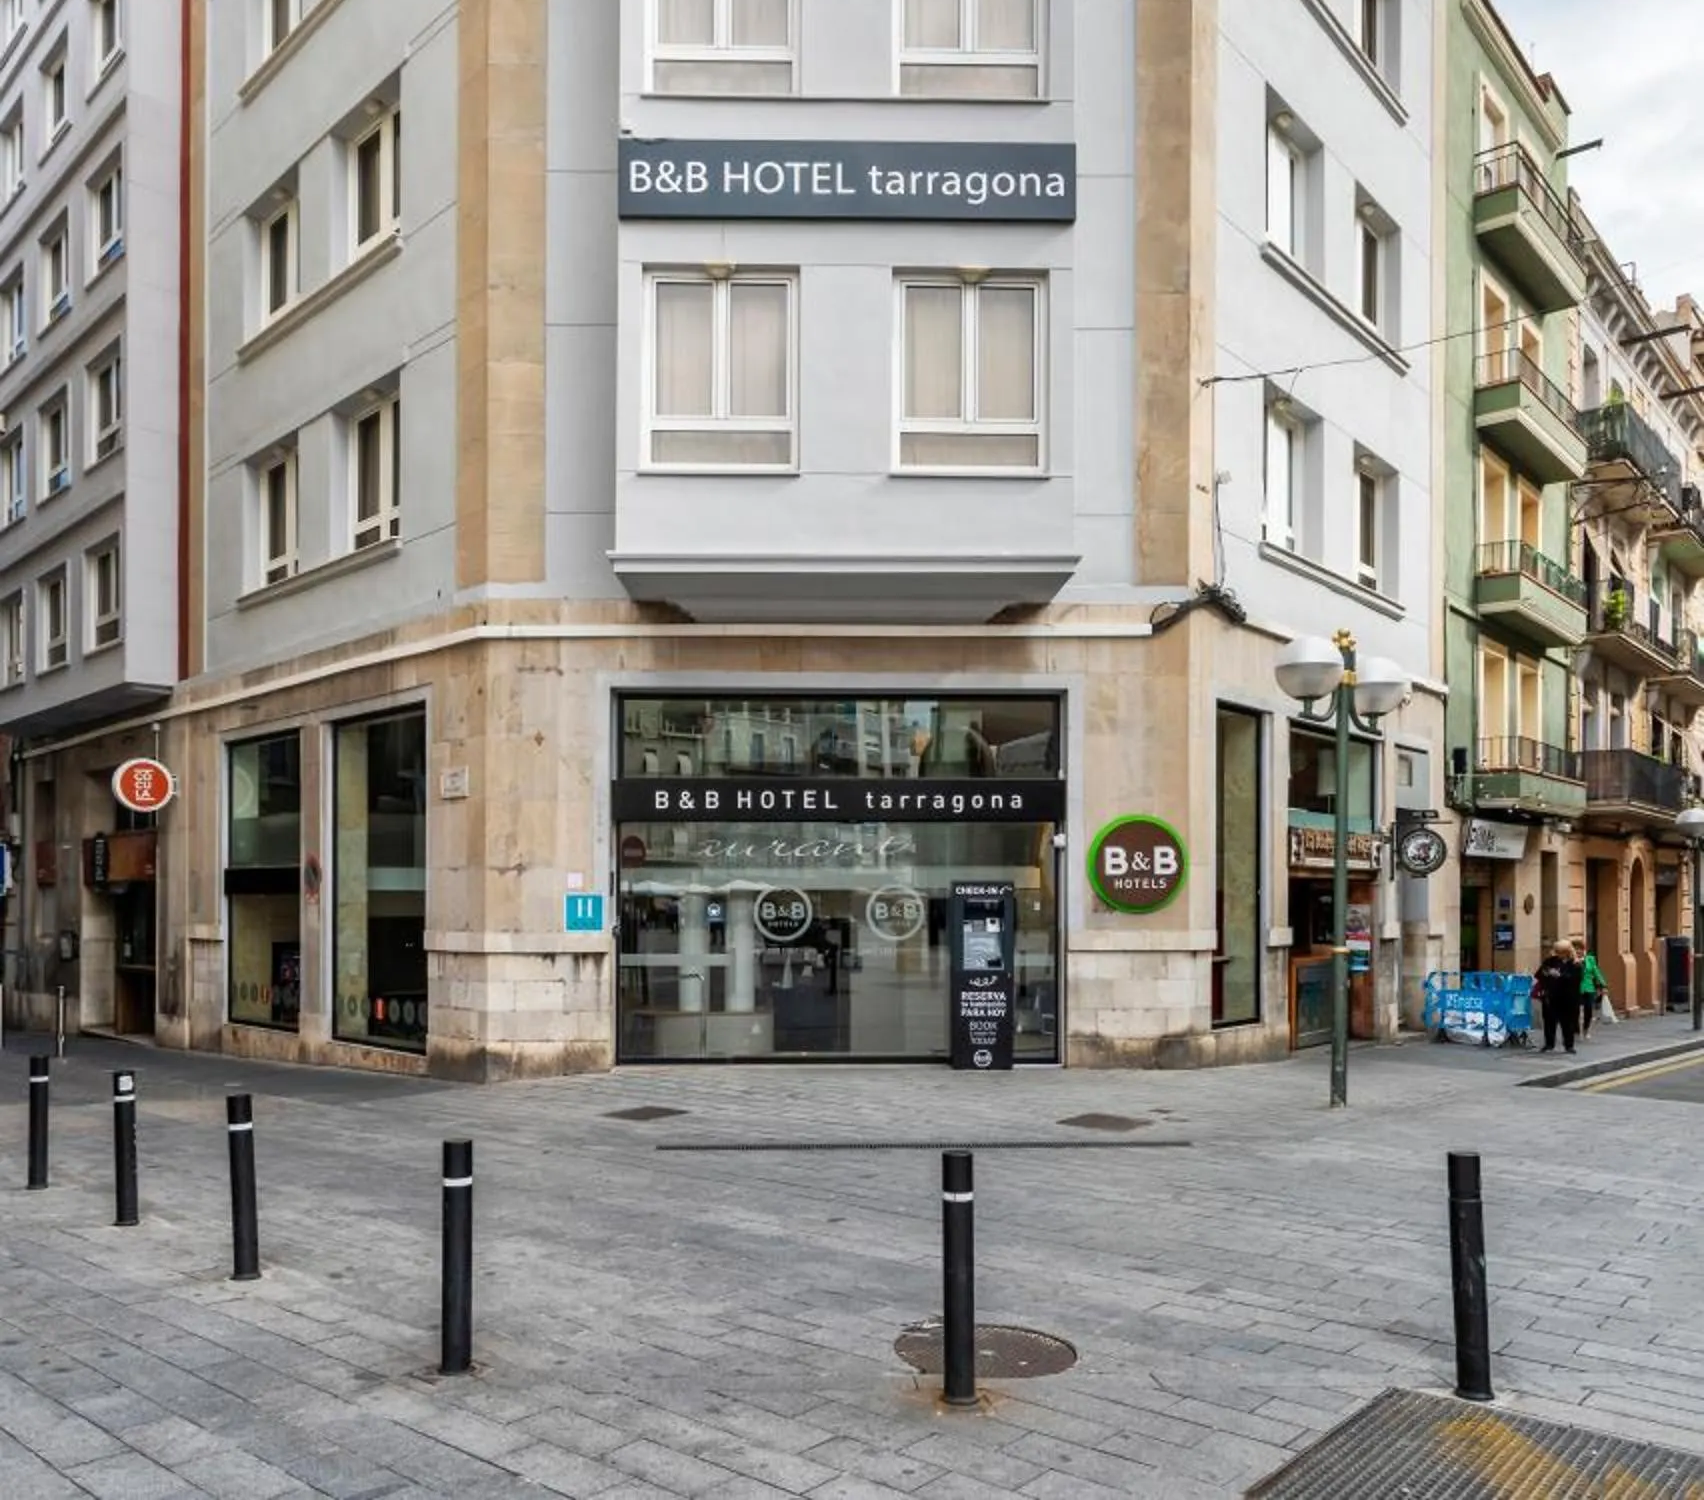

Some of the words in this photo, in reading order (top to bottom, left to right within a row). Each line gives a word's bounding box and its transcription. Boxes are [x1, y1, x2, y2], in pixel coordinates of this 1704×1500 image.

[629, 159, 709, 194] B&B
[723, 160, 857, 195] HOTEL
[867, 164, 1066, 205] tarragona
[655, 790, 720, 809] B&B
[737, 790, 839, 809] HOTEL
[865, 791, 1023, 813] tarragona
[1104, 845, 1178, 876] B&B
[1114, 878, 1167, 889] HOTELS
[762, 902, 804, 920] B&B
[875, 902, 917, 920] B&B
